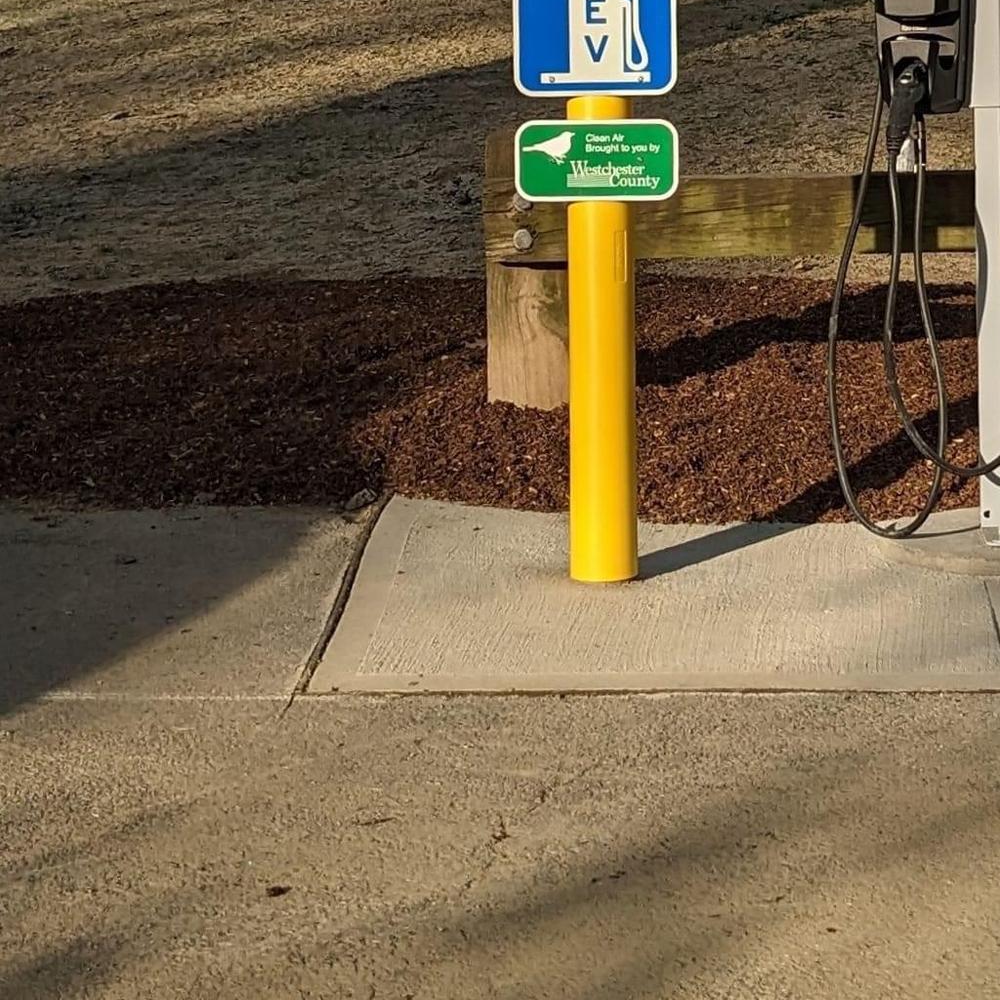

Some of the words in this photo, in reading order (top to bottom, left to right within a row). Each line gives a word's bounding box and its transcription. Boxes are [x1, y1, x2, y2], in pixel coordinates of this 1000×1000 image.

[585, 133, 610, 142] Clean
[611, 133, 625, 142] Air
[585, 143, 619, 154] Brought
[621, 143, 630, 152] to
[631, 144, 647, 154] you
[648, 143, 660, 153] by
[569, 160, 645, 178] Westchester
[609, 174, 660, 189] County
